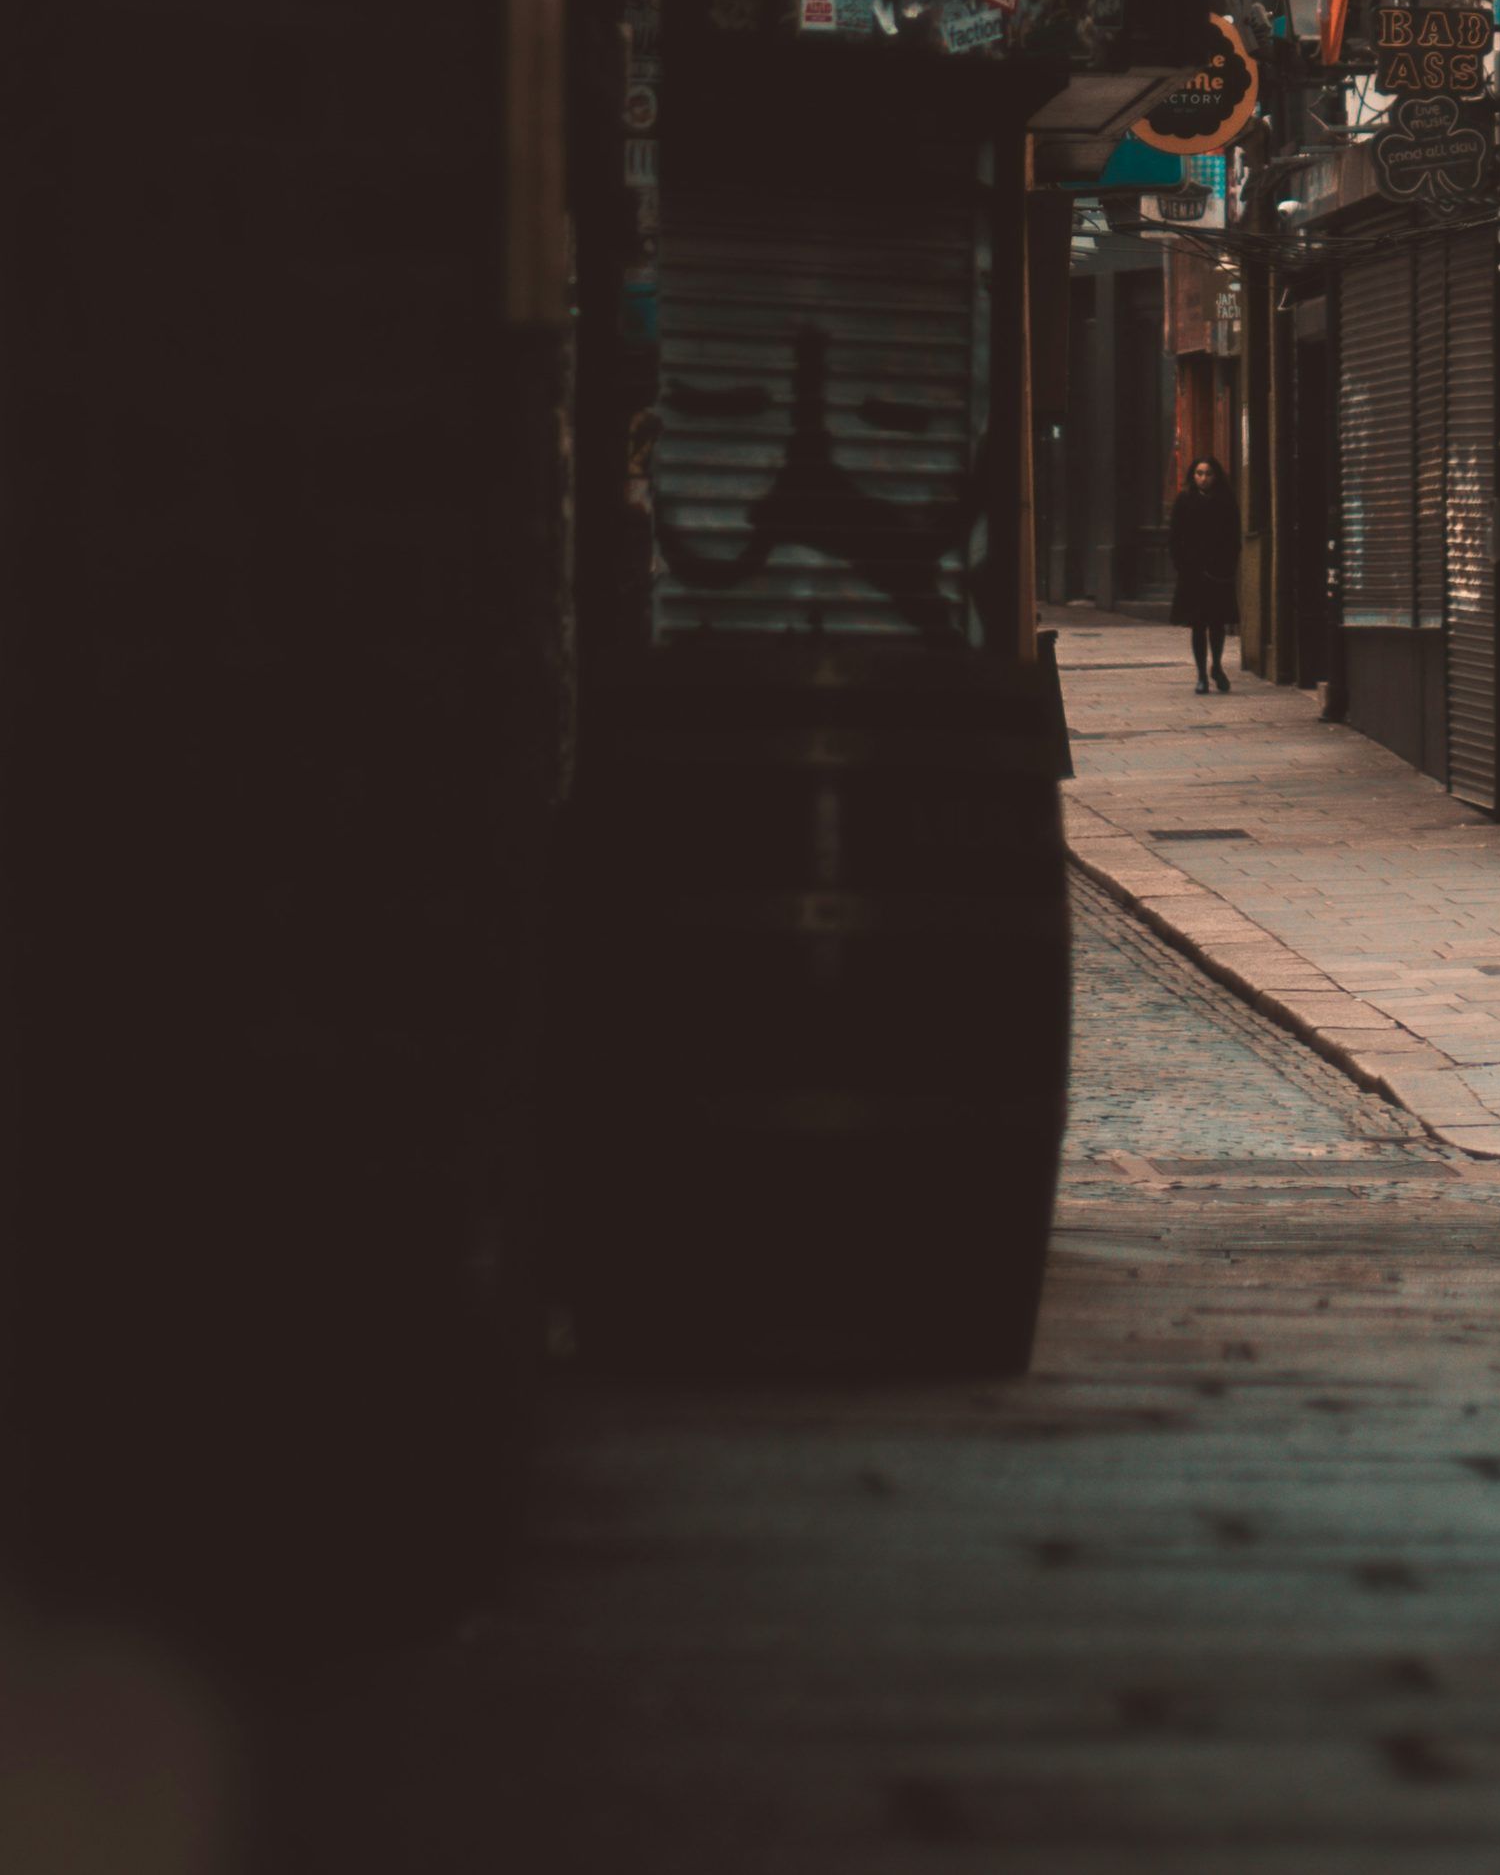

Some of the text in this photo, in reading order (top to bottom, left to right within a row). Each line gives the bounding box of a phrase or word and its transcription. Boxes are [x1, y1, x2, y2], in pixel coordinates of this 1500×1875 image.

[1378, 9, 1490, 49] BAD
[1384, 51, 1479, 89] ASS
[1164, 93, 1223, 105] CTORY
